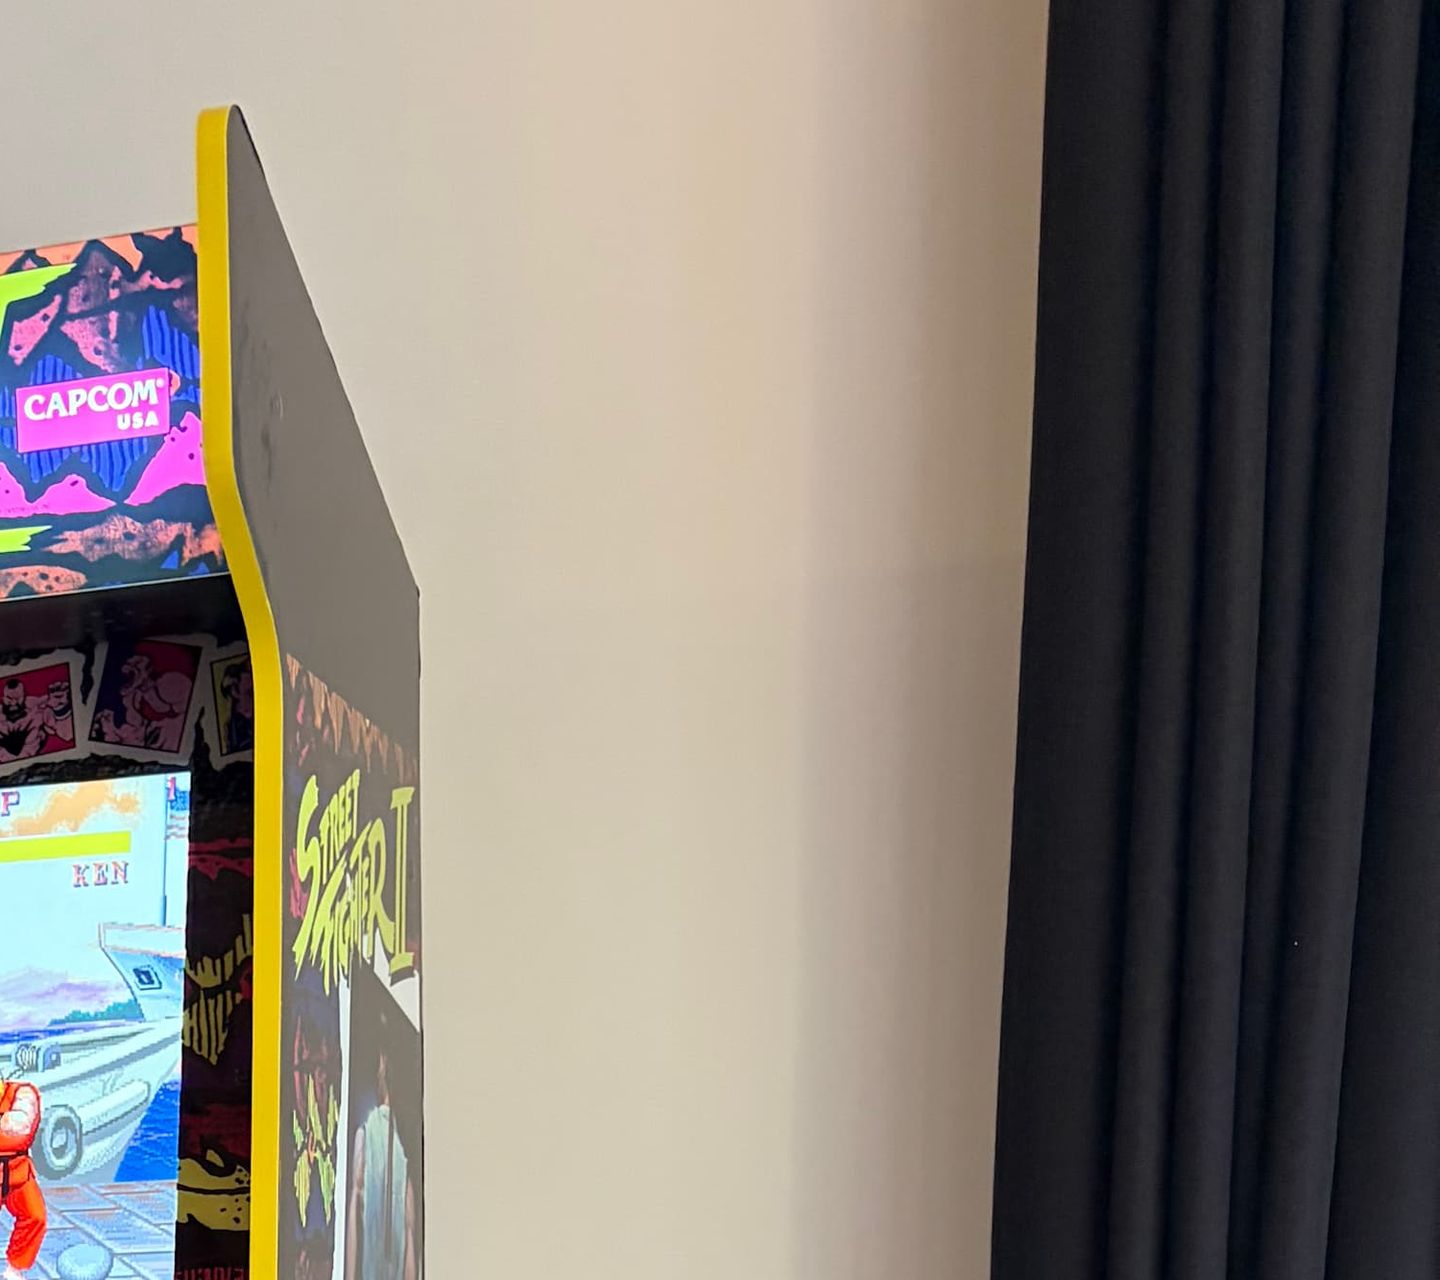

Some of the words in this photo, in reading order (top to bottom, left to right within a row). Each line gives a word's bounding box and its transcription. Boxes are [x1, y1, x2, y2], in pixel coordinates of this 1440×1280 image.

[24, 379, 159, 420] CAPCOM
[117, 411, 159, 430] USA
[73, 861, 129, 888] KEN
[292, 769, 360, 981] STREET
[310, 820, 395, 997] FIGHTER
